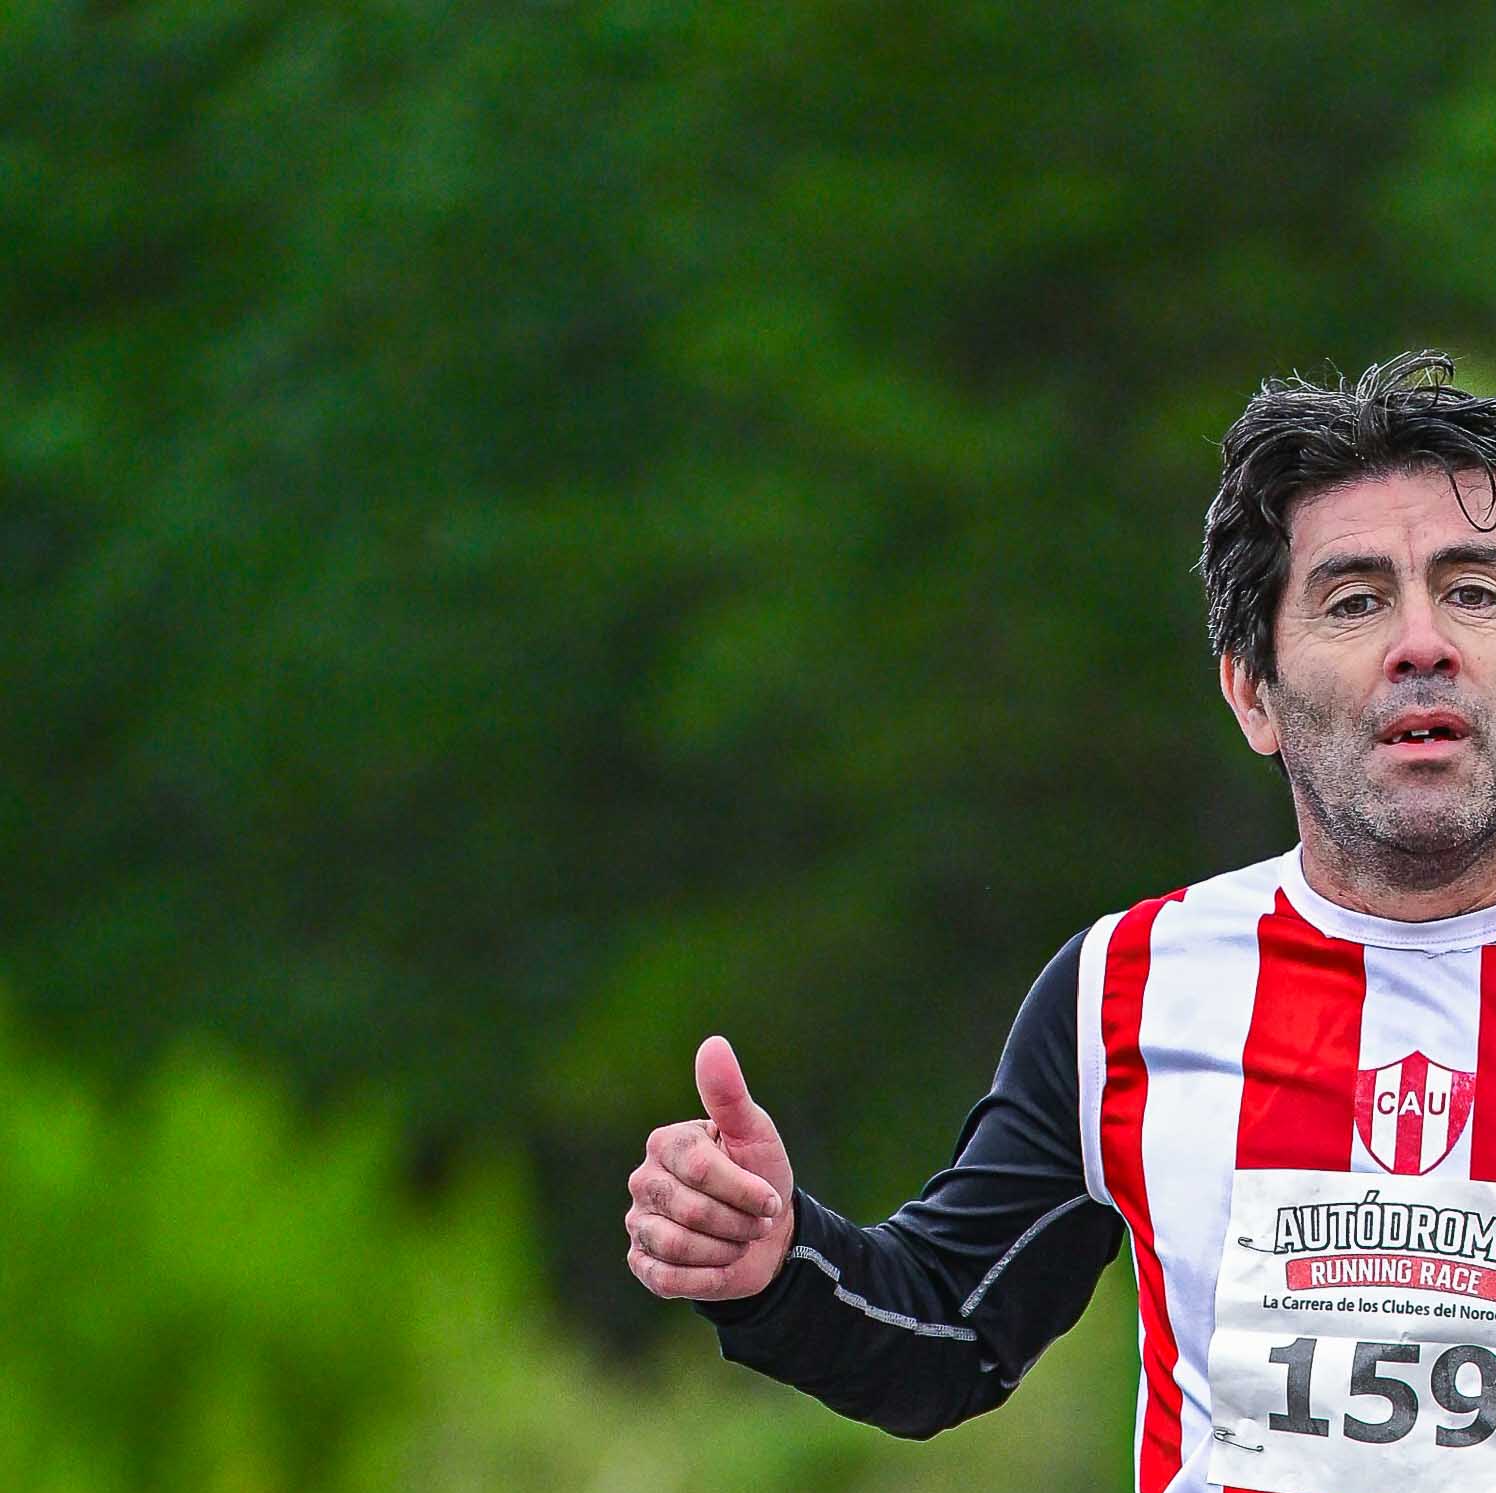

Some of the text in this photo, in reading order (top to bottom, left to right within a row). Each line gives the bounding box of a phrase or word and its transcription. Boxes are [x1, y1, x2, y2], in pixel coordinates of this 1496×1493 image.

[1376, 1091, 1449, 1117] CAU
[1310, 1257, 1483, 1295] RUNNING RACE
[1263, 1295, 1278, 1309] La
[1282, 1296, 1333, 1311] Carrera
[1337, 1298, 1355, 1312] de
[1359, 1298, 1378, 1313] los
[1382, 1299, 1430, 1316] Clubes
[1433, 1303, 1456, 1318] del
